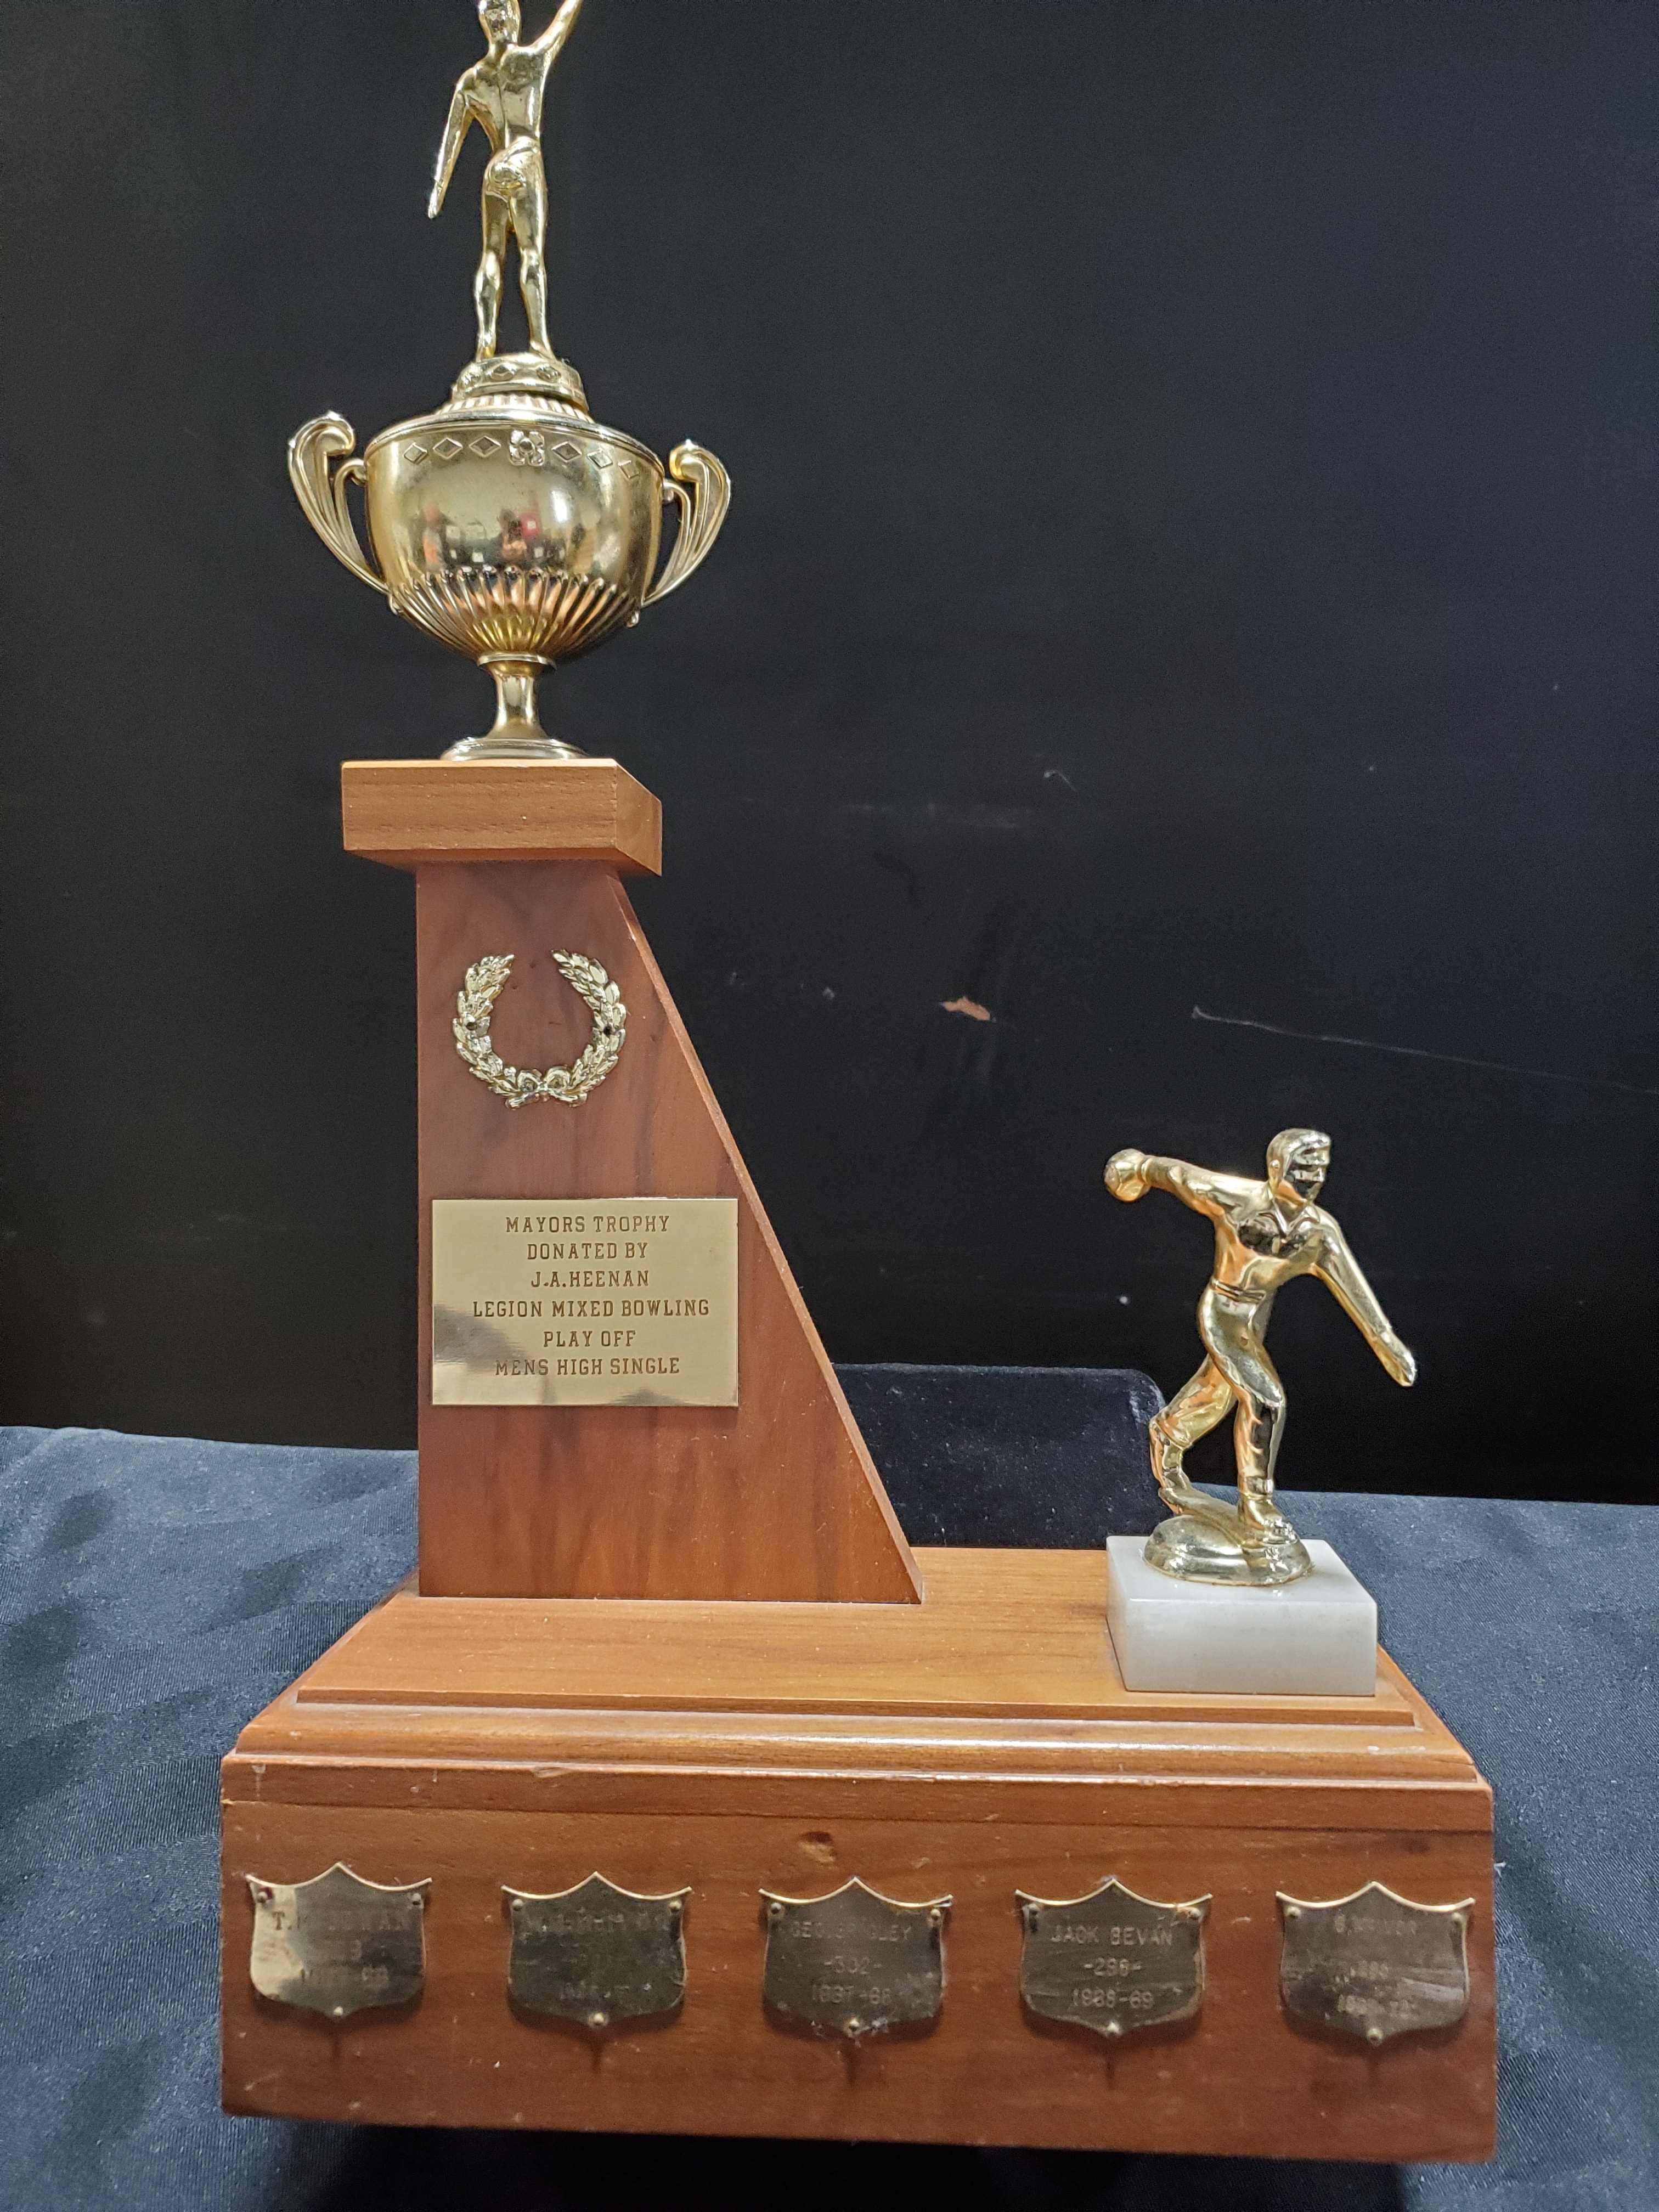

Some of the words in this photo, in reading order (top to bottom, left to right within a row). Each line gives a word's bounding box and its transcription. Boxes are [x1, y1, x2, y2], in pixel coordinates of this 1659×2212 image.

[506, 1216, 585, 1233] MAYORS
[594, 1215, 669, 1232] TROPHY
[527, 1242, 617, 1260] DONATED
[625, 1242, 648, 1259] BY
[531, 1271, 649, 1288] J.A.HEENAN
[473, 1301, 543, 1317] LEGION
[552, 1300, 614, 1317] MIXED
[622, 1299, 709, 1316] BOWLING
[544, 1331, 592, 1347] PLAY
[601, 1330, 636, 1346] OFF
[495, 1359, 549, 1375] MENS
[557, 1358, 602, 1375] HIGH
[610, 1357, 680, 1374] SINGLE
[1050, 1925, 1099, 1944] JACK
[1110, 1925, 1173, 1946] BEVAN
